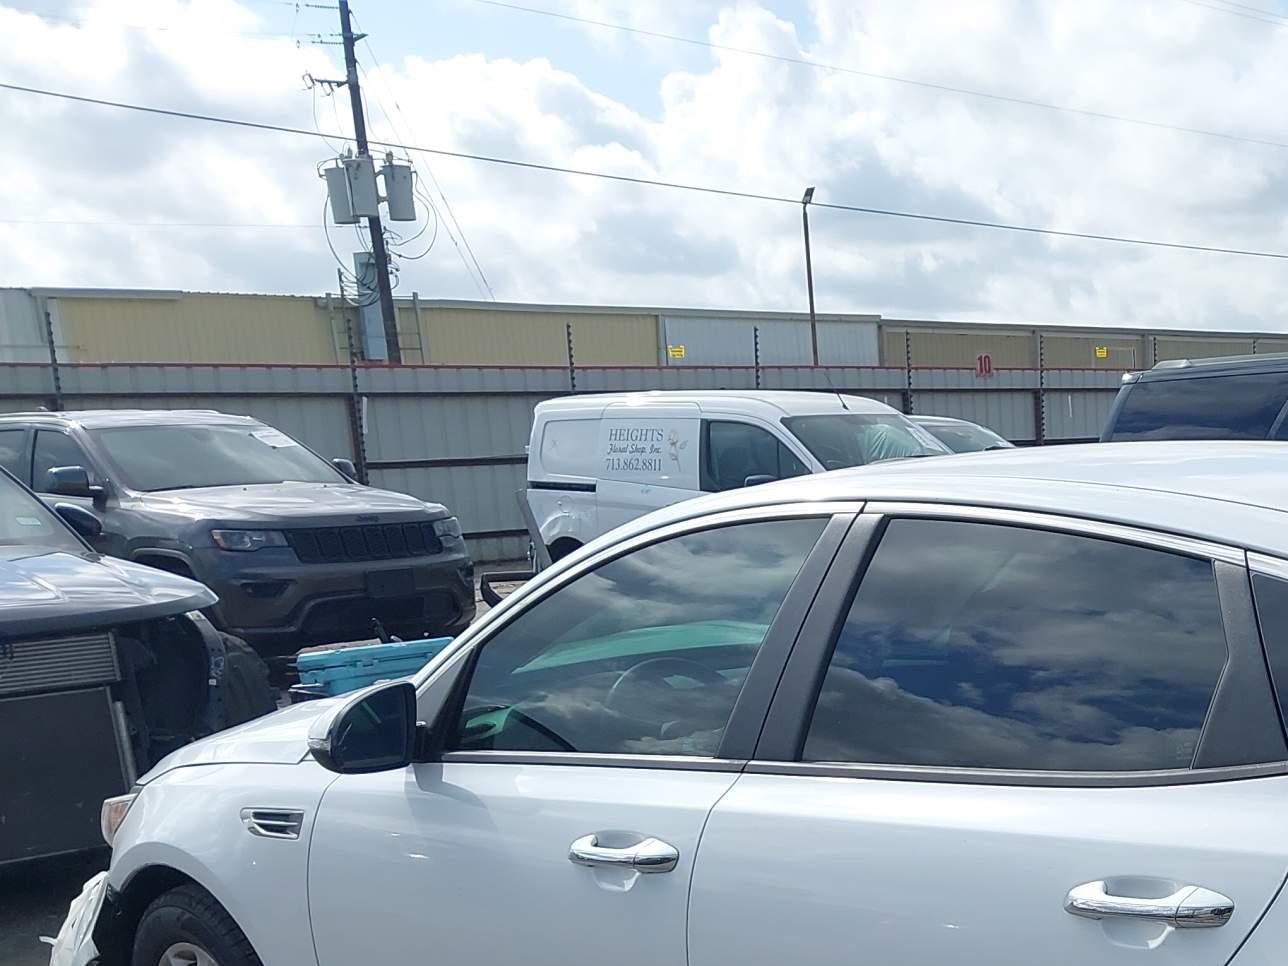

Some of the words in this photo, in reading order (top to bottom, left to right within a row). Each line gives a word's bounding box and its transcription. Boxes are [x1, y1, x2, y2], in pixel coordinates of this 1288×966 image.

[977, 354, 992, 376] 10
[608, 428, 664, 442] HEIGHTS
[607, 443, 629, 455] Floral
[605, 458, 662, 471] 713.862.8811
